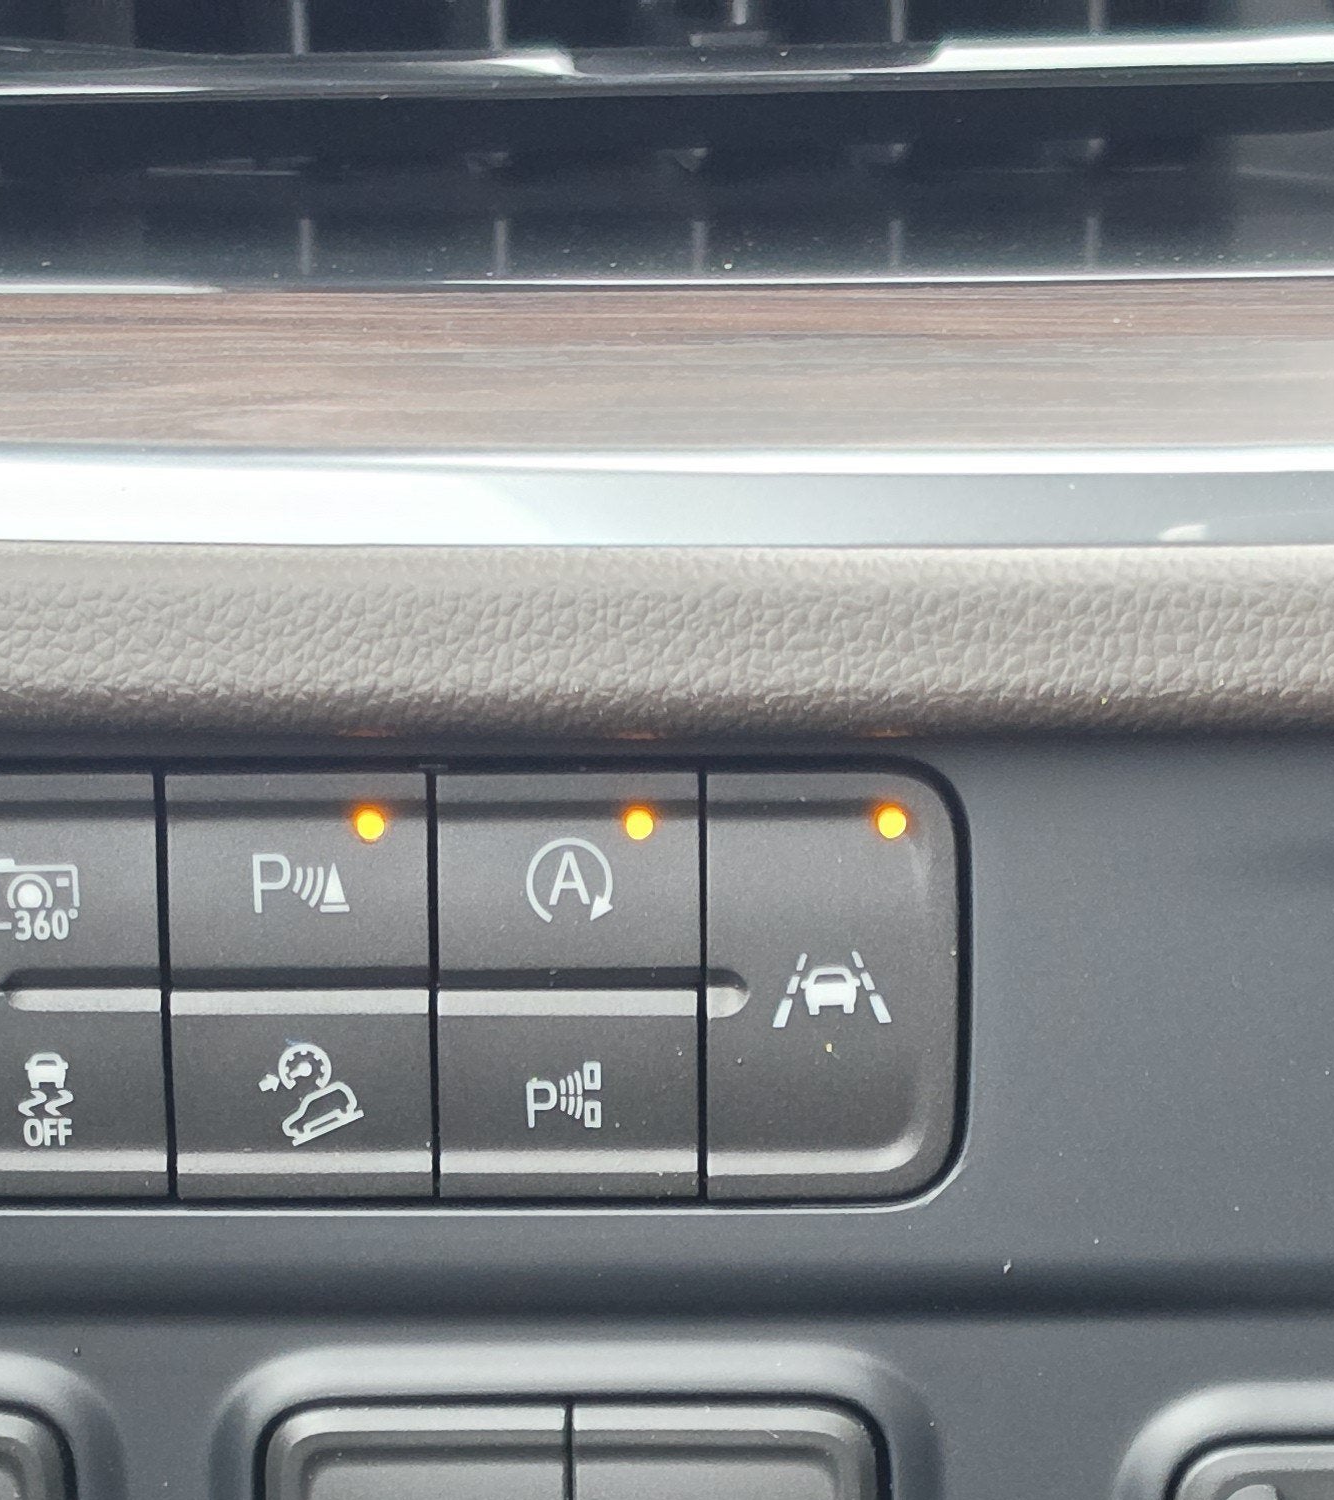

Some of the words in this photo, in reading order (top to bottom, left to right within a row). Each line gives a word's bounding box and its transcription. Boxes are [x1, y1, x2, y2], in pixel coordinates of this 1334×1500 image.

[251, 852, 291, 914] P
[546, 849, 592, 907] A
[525, 1080, 557, 1129] P
[22, 1118, 73, 1147] OFF
